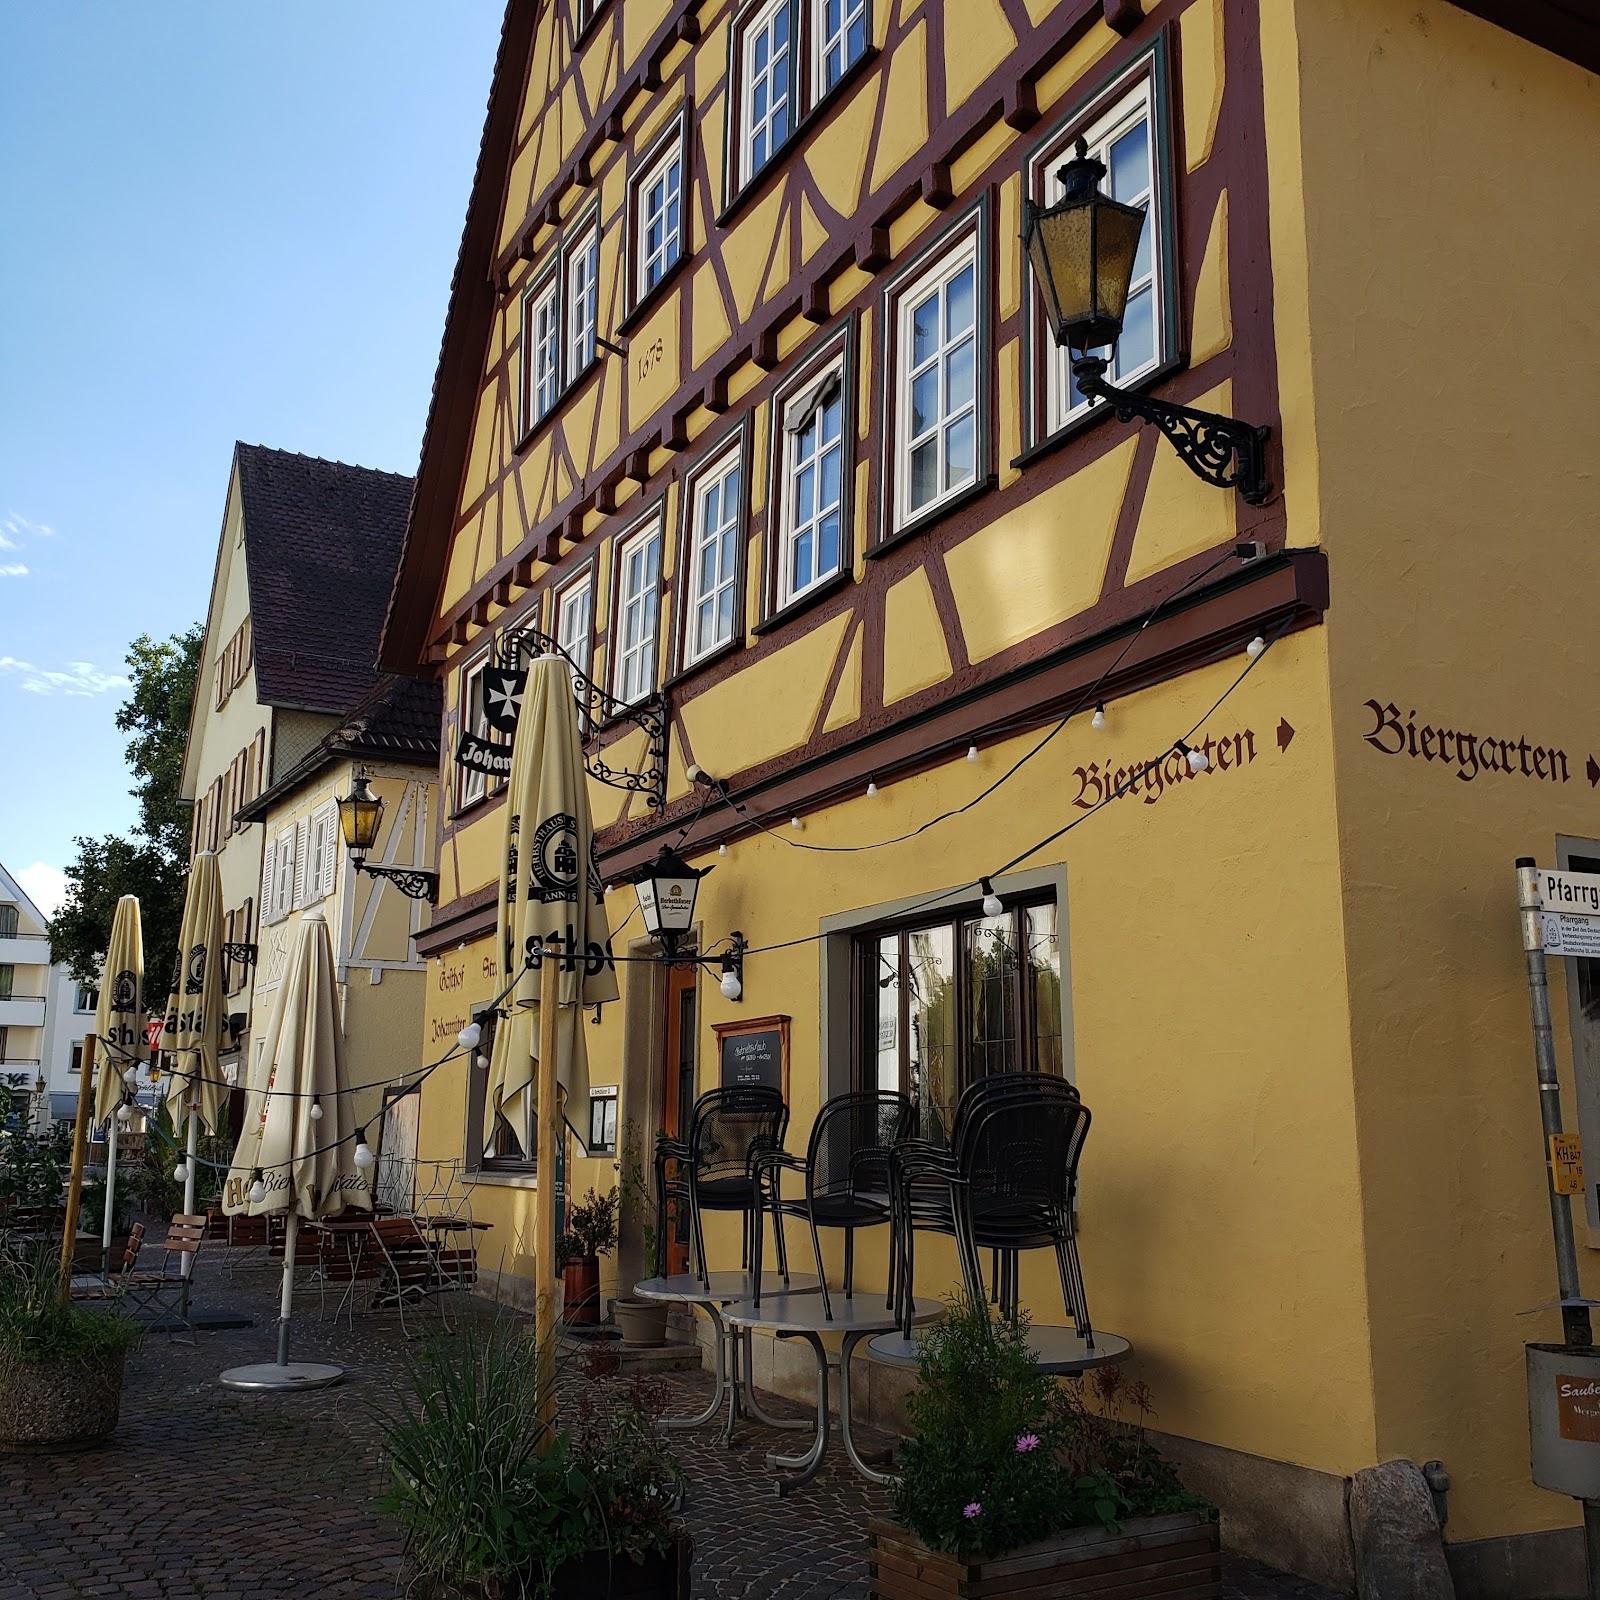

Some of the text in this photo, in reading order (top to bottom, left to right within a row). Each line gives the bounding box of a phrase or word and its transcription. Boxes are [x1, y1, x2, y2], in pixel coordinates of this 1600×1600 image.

[1363, 699, 1571, 783] Biergarten
[462, 742, 513, 770] Johan
[1547, 876, 1600, 910] Pfarrg
[1560, 915, 1589, 926] Pfarrgang
[1556, 1147, 1569, 1160] KH
[1561, 1382, 1600, 1397] Saube
